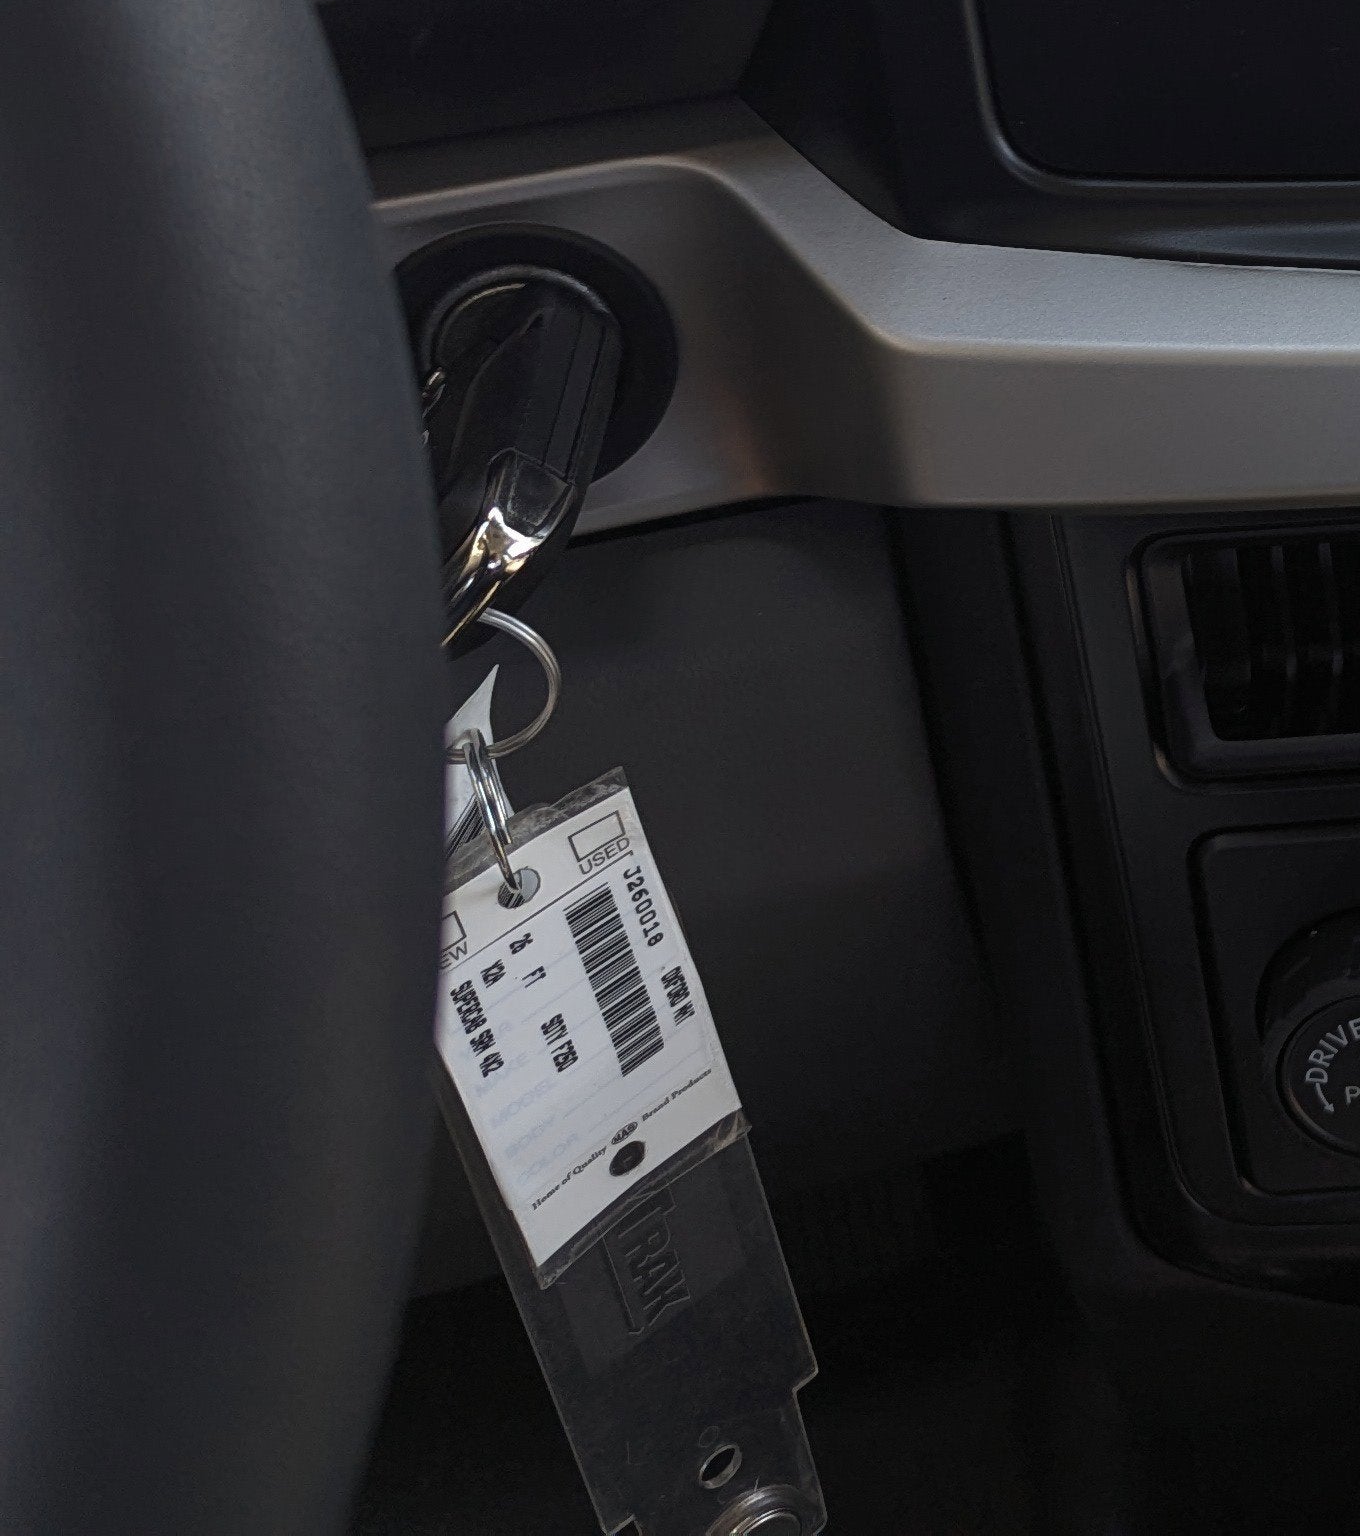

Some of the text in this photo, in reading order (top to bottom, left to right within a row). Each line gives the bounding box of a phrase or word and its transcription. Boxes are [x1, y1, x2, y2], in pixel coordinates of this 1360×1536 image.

[579, 836, 630, 876] USED
[623, 865, 664, 948] J260018
[551, 1039, 579, 1073] F250
[532, 1184, 560, 1210] Home
[573, 1146, 607, 1175] Quality
[643, 1097, 670, 1122] Brand
[671, 1068, 712, 1100] Products
